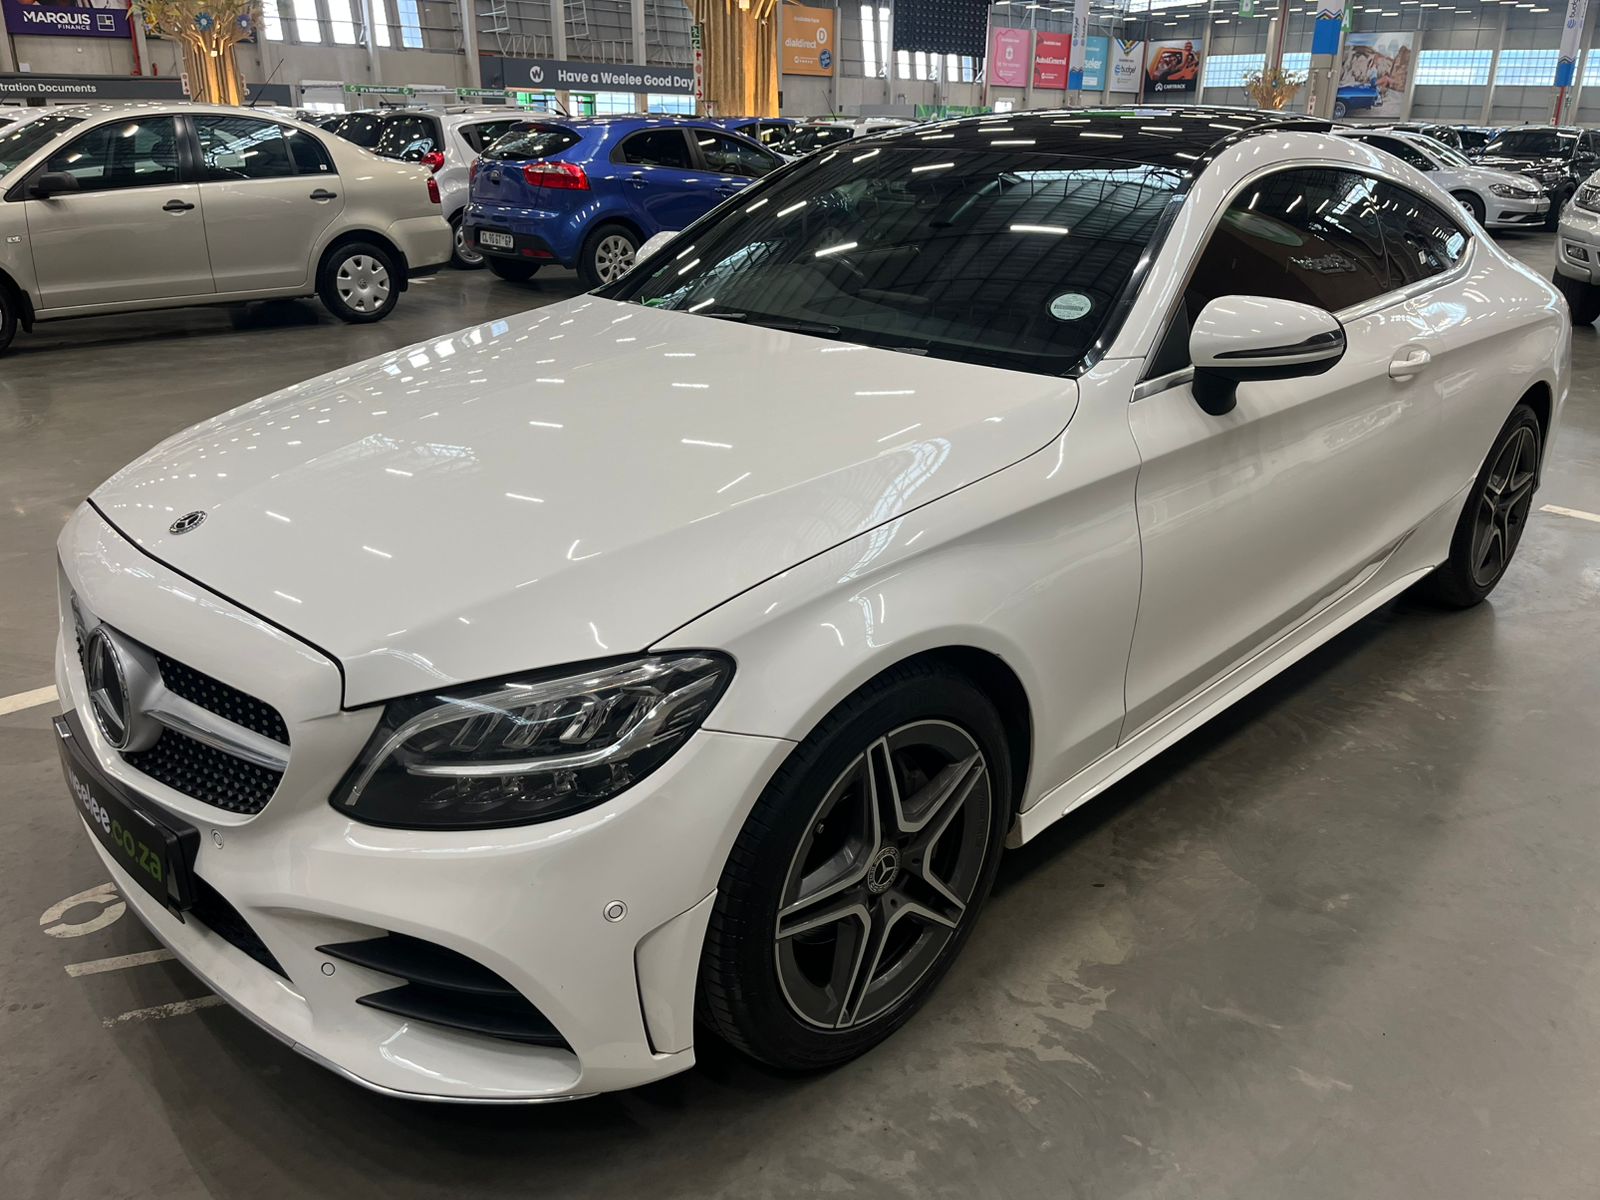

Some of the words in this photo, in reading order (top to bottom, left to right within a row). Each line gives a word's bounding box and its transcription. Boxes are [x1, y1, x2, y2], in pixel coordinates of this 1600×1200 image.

[23, 11, 91, 25] MARQUIS
[1341, 9, 1350, 28] A
[0, 83, 37, 92] tration
[38, 83, 97, 93] Documents
[558, 69, 589, 82] Have
[591, 73, 599, 83] a
[600, 72, 642, 85] Weelee
[644, 75, 672, 87] Good
[674, 76, 694, 91] Day
